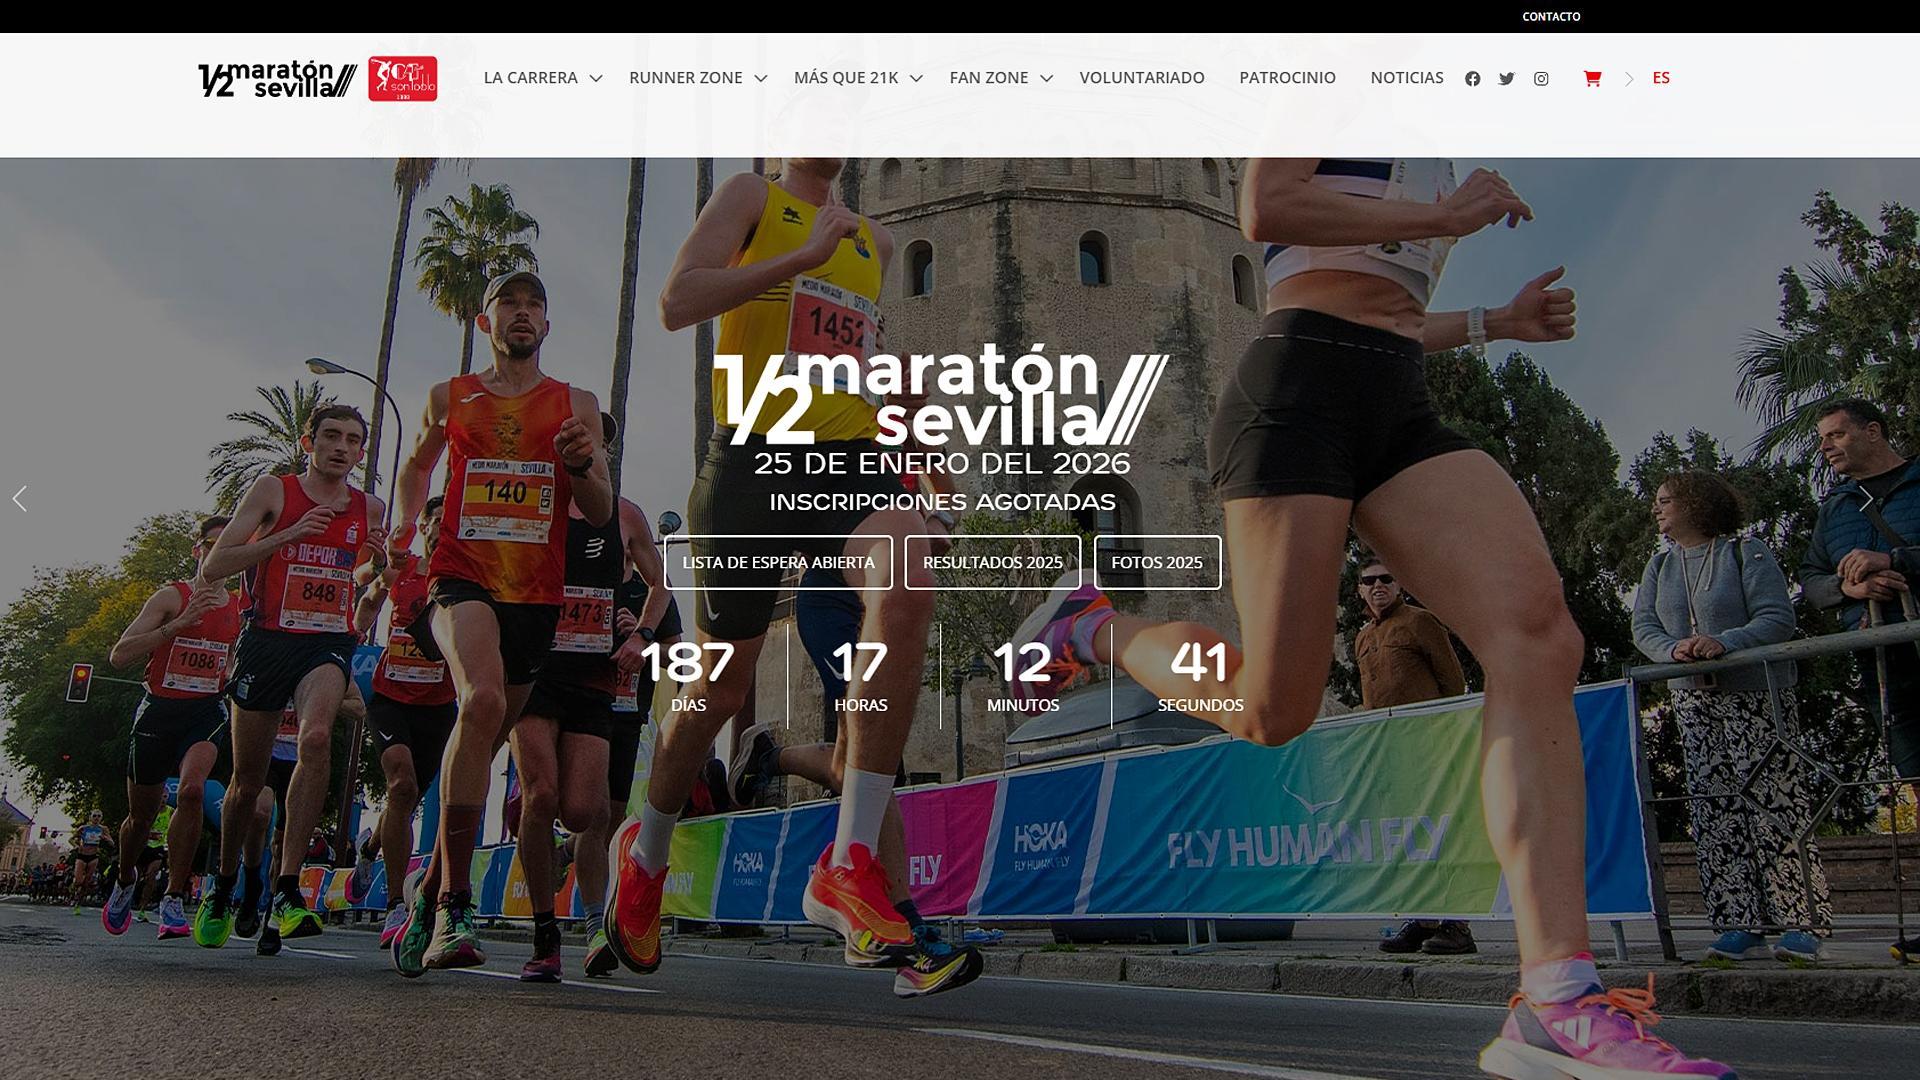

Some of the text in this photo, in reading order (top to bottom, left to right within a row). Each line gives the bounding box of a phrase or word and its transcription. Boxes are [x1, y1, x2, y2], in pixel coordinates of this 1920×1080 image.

[811, 306, 864, 348] 1452
[484, 479, 527, 504] 140
[303, 582, 336, 602] 848
[561, 603, 602, 622] 1473
[181, 651, 216, 670] 1088
[1013, 820, 1068, 853] HOKA
[1167, 814, 1450, 870] FLY HUMAN FLY
[733, 851, 764, 873] HOKA
[909, 854, 943, 886] FLY
